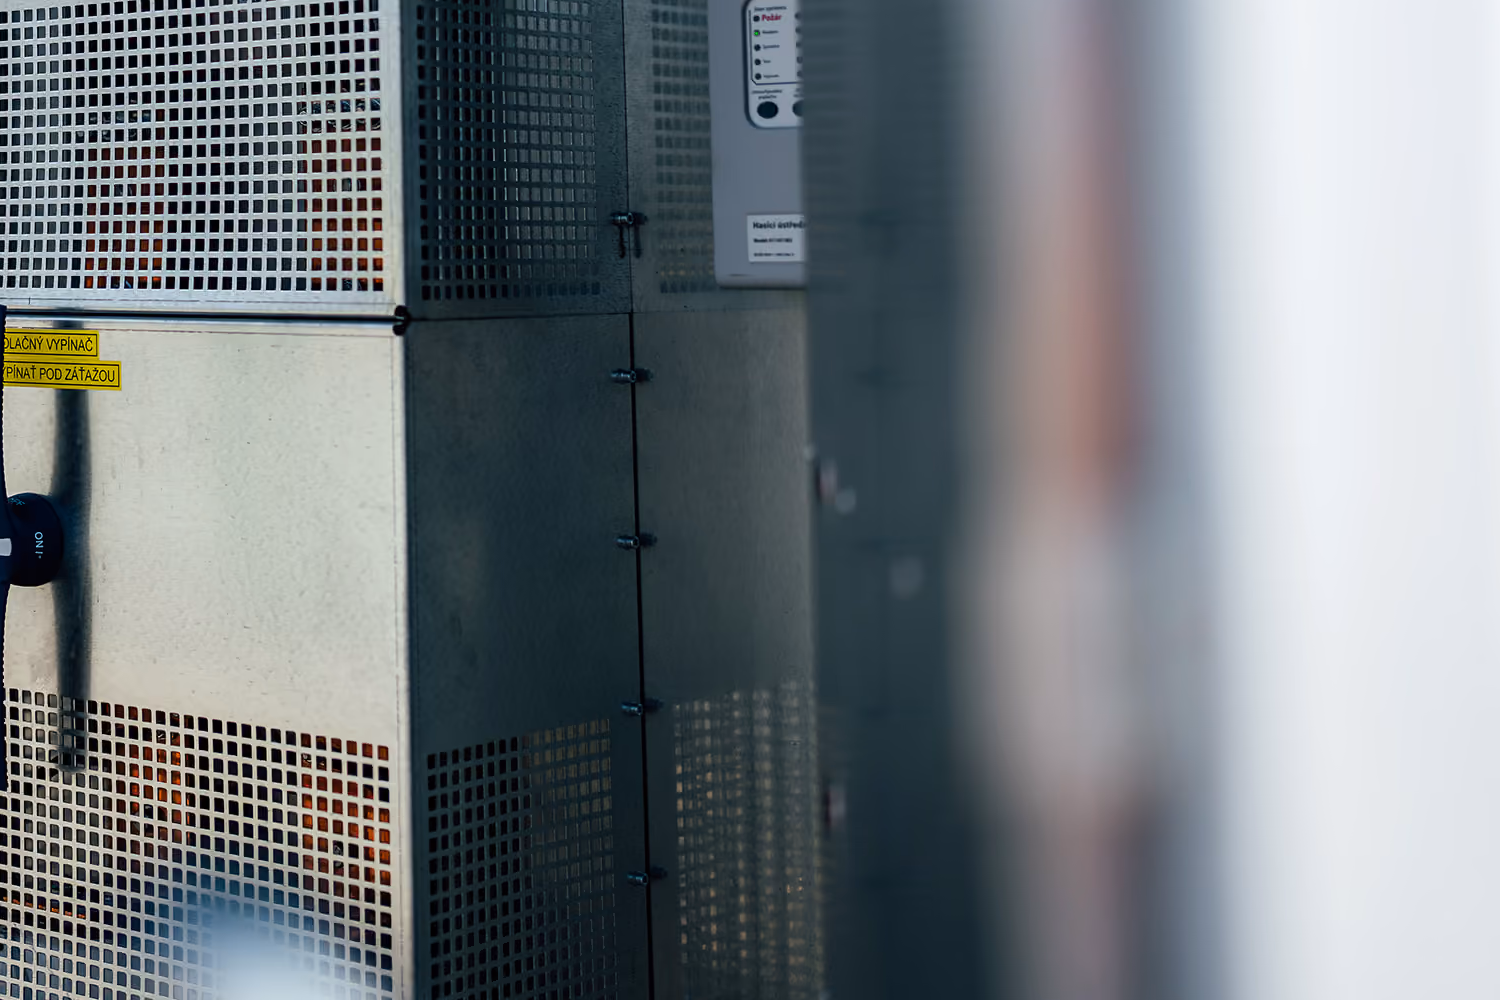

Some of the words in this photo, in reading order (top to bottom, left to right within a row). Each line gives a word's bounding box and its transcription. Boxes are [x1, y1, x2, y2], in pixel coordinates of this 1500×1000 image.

[46, 335, 93, 352] VYPÍNAČ
[39, 367, 63, 381] POD
[64, 366, 115, 383] ZÁŤAŽOU
[34, 531, 44, 548] ON
